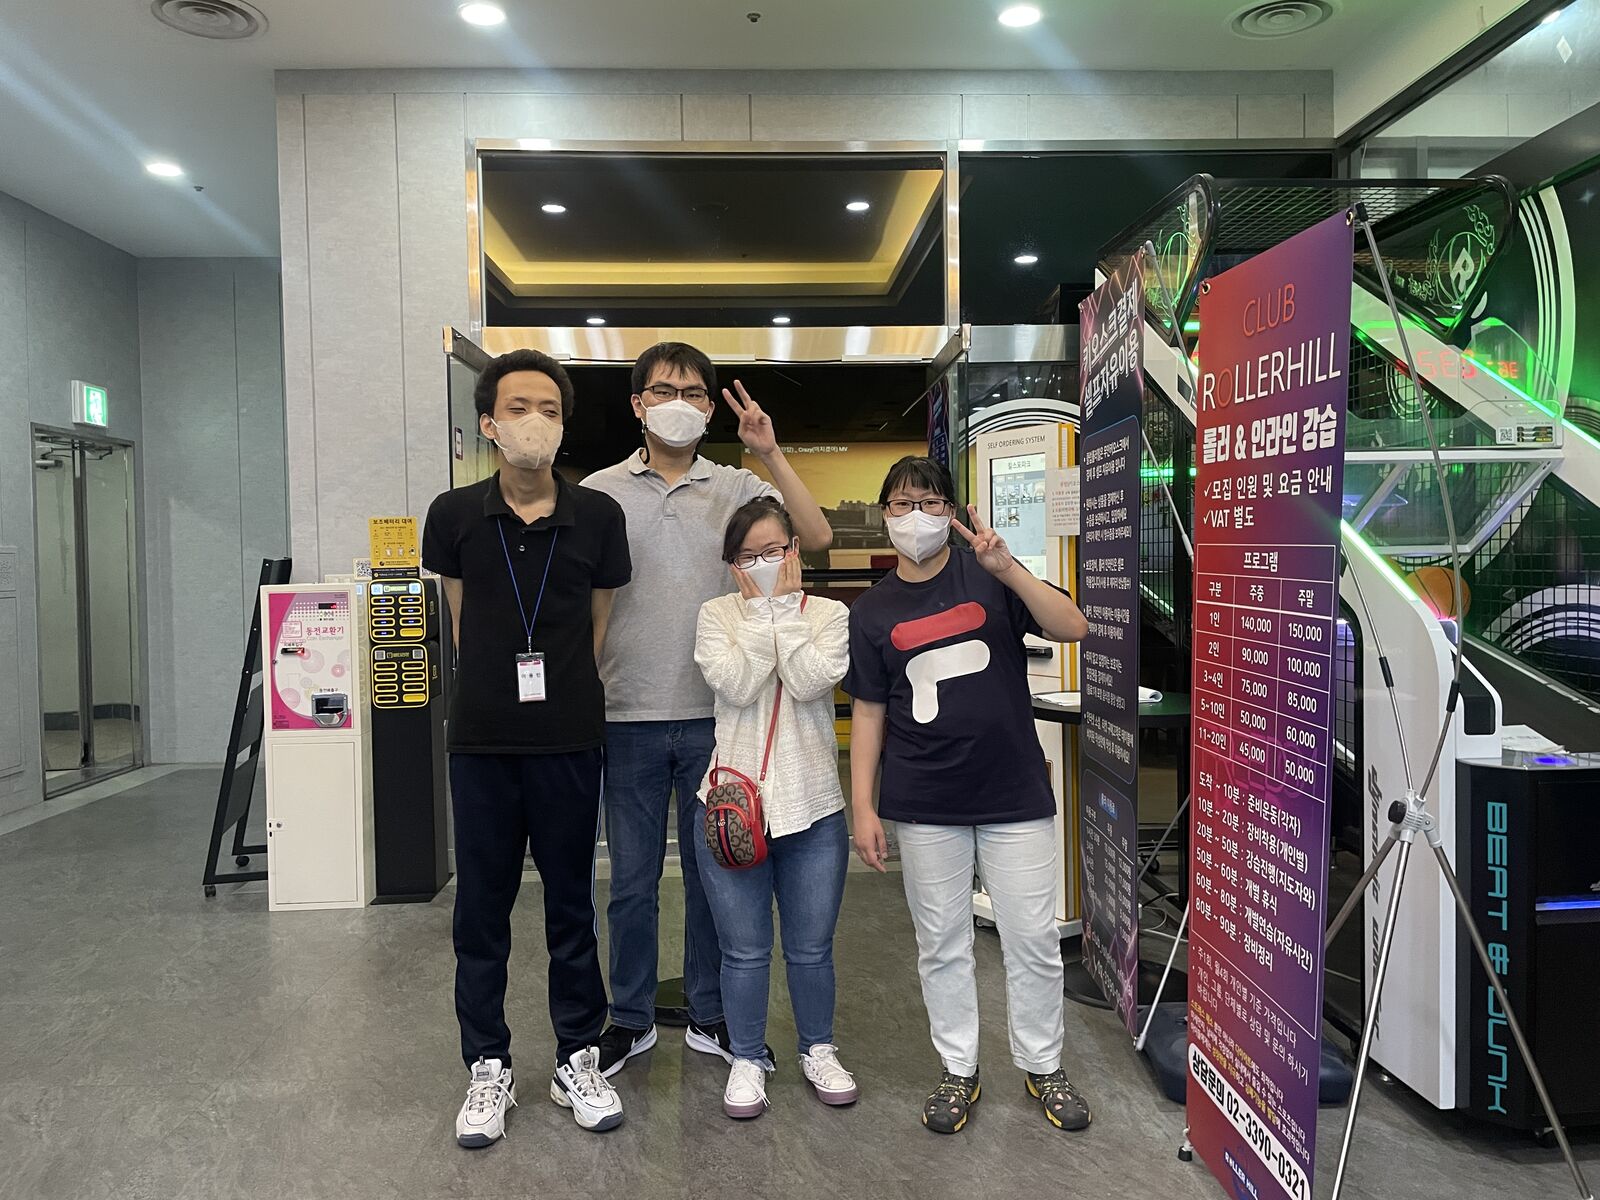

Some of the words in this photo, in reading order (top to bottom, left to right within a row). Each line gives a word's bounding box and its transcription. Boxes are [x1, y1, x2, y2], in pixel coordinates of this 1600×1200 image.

[1083, 277, 1138, 376] 키오스크결제
[1243, 283, 1296, 337] CLUB
[1084, 329, 1139, 421] 셀프자유이용
[1202, 332, 1341, 411] ROLLERHILL
[987, 441, 999, 450] SELF
[999, 437, 1024, 448] ORDERING
[1025, 435, 1046, 445] SYSTEM
[1203, 424, 1231, 464] 롤러
[1234, 424, 1247, 460] &
[1251, 411, 1298, 459] 인라인
[1302, 404, 1337, 451] 강습
[1211, 477, 1232, 501] 모집
[1236, 474, 1257, 499] 인원
[1262, 472, 1273, 499] 및
[1277, 470, 1302, 496] 요금
[1307, 465, 1333, 494] 안내
[1211, 509, 1230, 528] VAT
[1233, 505, 1254, 529] 별도
[1243, 551, 1279, 573] 프로그램
[1208, 581, 1222, 598] 구분
[1249, 584, 1265, 602] 주중
[1298, 589, 1315, 609] 주말
[306, 626, 344, 637] 동전교환기
[1209, 612, 1220, 628] 1인
[1240, 615, 1272, 634] 140,000
[1288, 622, 1322, 643] 150,000
[1208, 641, 1220, 658] 2인
[1241, 647, 1269, 666] 90,000
[1287, 657, 1321, 679] 100,000
[1203, 670, 1224, 688] 3~4인
[1241, 678, 1268, 698] 75,000
[1287, 692, 1317, 714] 85,000
[1200, 699, 1225, 719] 5~10인
[1240, 710, 1267, 731] 50,000
[1286, 726, 1316, 749] 60,000
[1198, 726, 1227, 750] 11~20인
[1239, 741, 1266, 764] 45,000
[1285, 760, 1314, 786] 50,000
[1199, 771, 1213, 793] 도착
[1223, 784, 1240, 806] 10분
[1247, 793, 1301, 838] 준비운동(각자)
[1196, 821, 1213, 844] 20분
[1221, 835, 1239, 861] 50분
[1246, 849, 1315, 911] 강습진행(지도자와)
[1197, 797, 1213, 818] 10분
[1222, 810, 1239, 833] 20분
[1247, 822, 1309, 875] 장비착용(개인별)
[1487, 801, 1508, 931] BEAT
[1196, 848, 1213, 870] 50분
[1220, 863, 1238, 888] 60분
[1245, 878, 1260, 901] 개별
[1262, 890, 1278, 916] 휴식
[1195, 897, 1212, 921] 80분
[1219, 916, 1237, 942] 90분
[1243, 932, 1273, 972] 장비정리
[1196, 872, 1212, 896] 60분
[1220, 889, 1238, 916] 80분
[1244, 904, 1313, 974] 개별연습(자유시간)
[1487, 942, 1509, 975] &
[1196, 983, 1218, 1013] 바랍니다
[1230, 975, 1248, 1002] 개인별
[1250, 992, 1262, 1015] 기준
[1263, 1006, 1297, 1049] 가격입니다
[1225, 991, 1248, 1023] 단체별로
[1249, 1016, 1262, 1038] 상담
[1264, 1028, 1271, 1047] 및
[1272, 1037, 1286, 1063] 문의
[1288, 1052, 1309, 1087] 하시기
[1487, 986, 1508, 1115] DUNK
[1192, 1050, 1225, 1107] 상담문의
[1226, 1091, 1306, 1200] 02-3390-0321
[1277, 1105, 1306, 1145] 스포츠입니다
[1281, 1124, 1311, 1165] 효과적입니다
